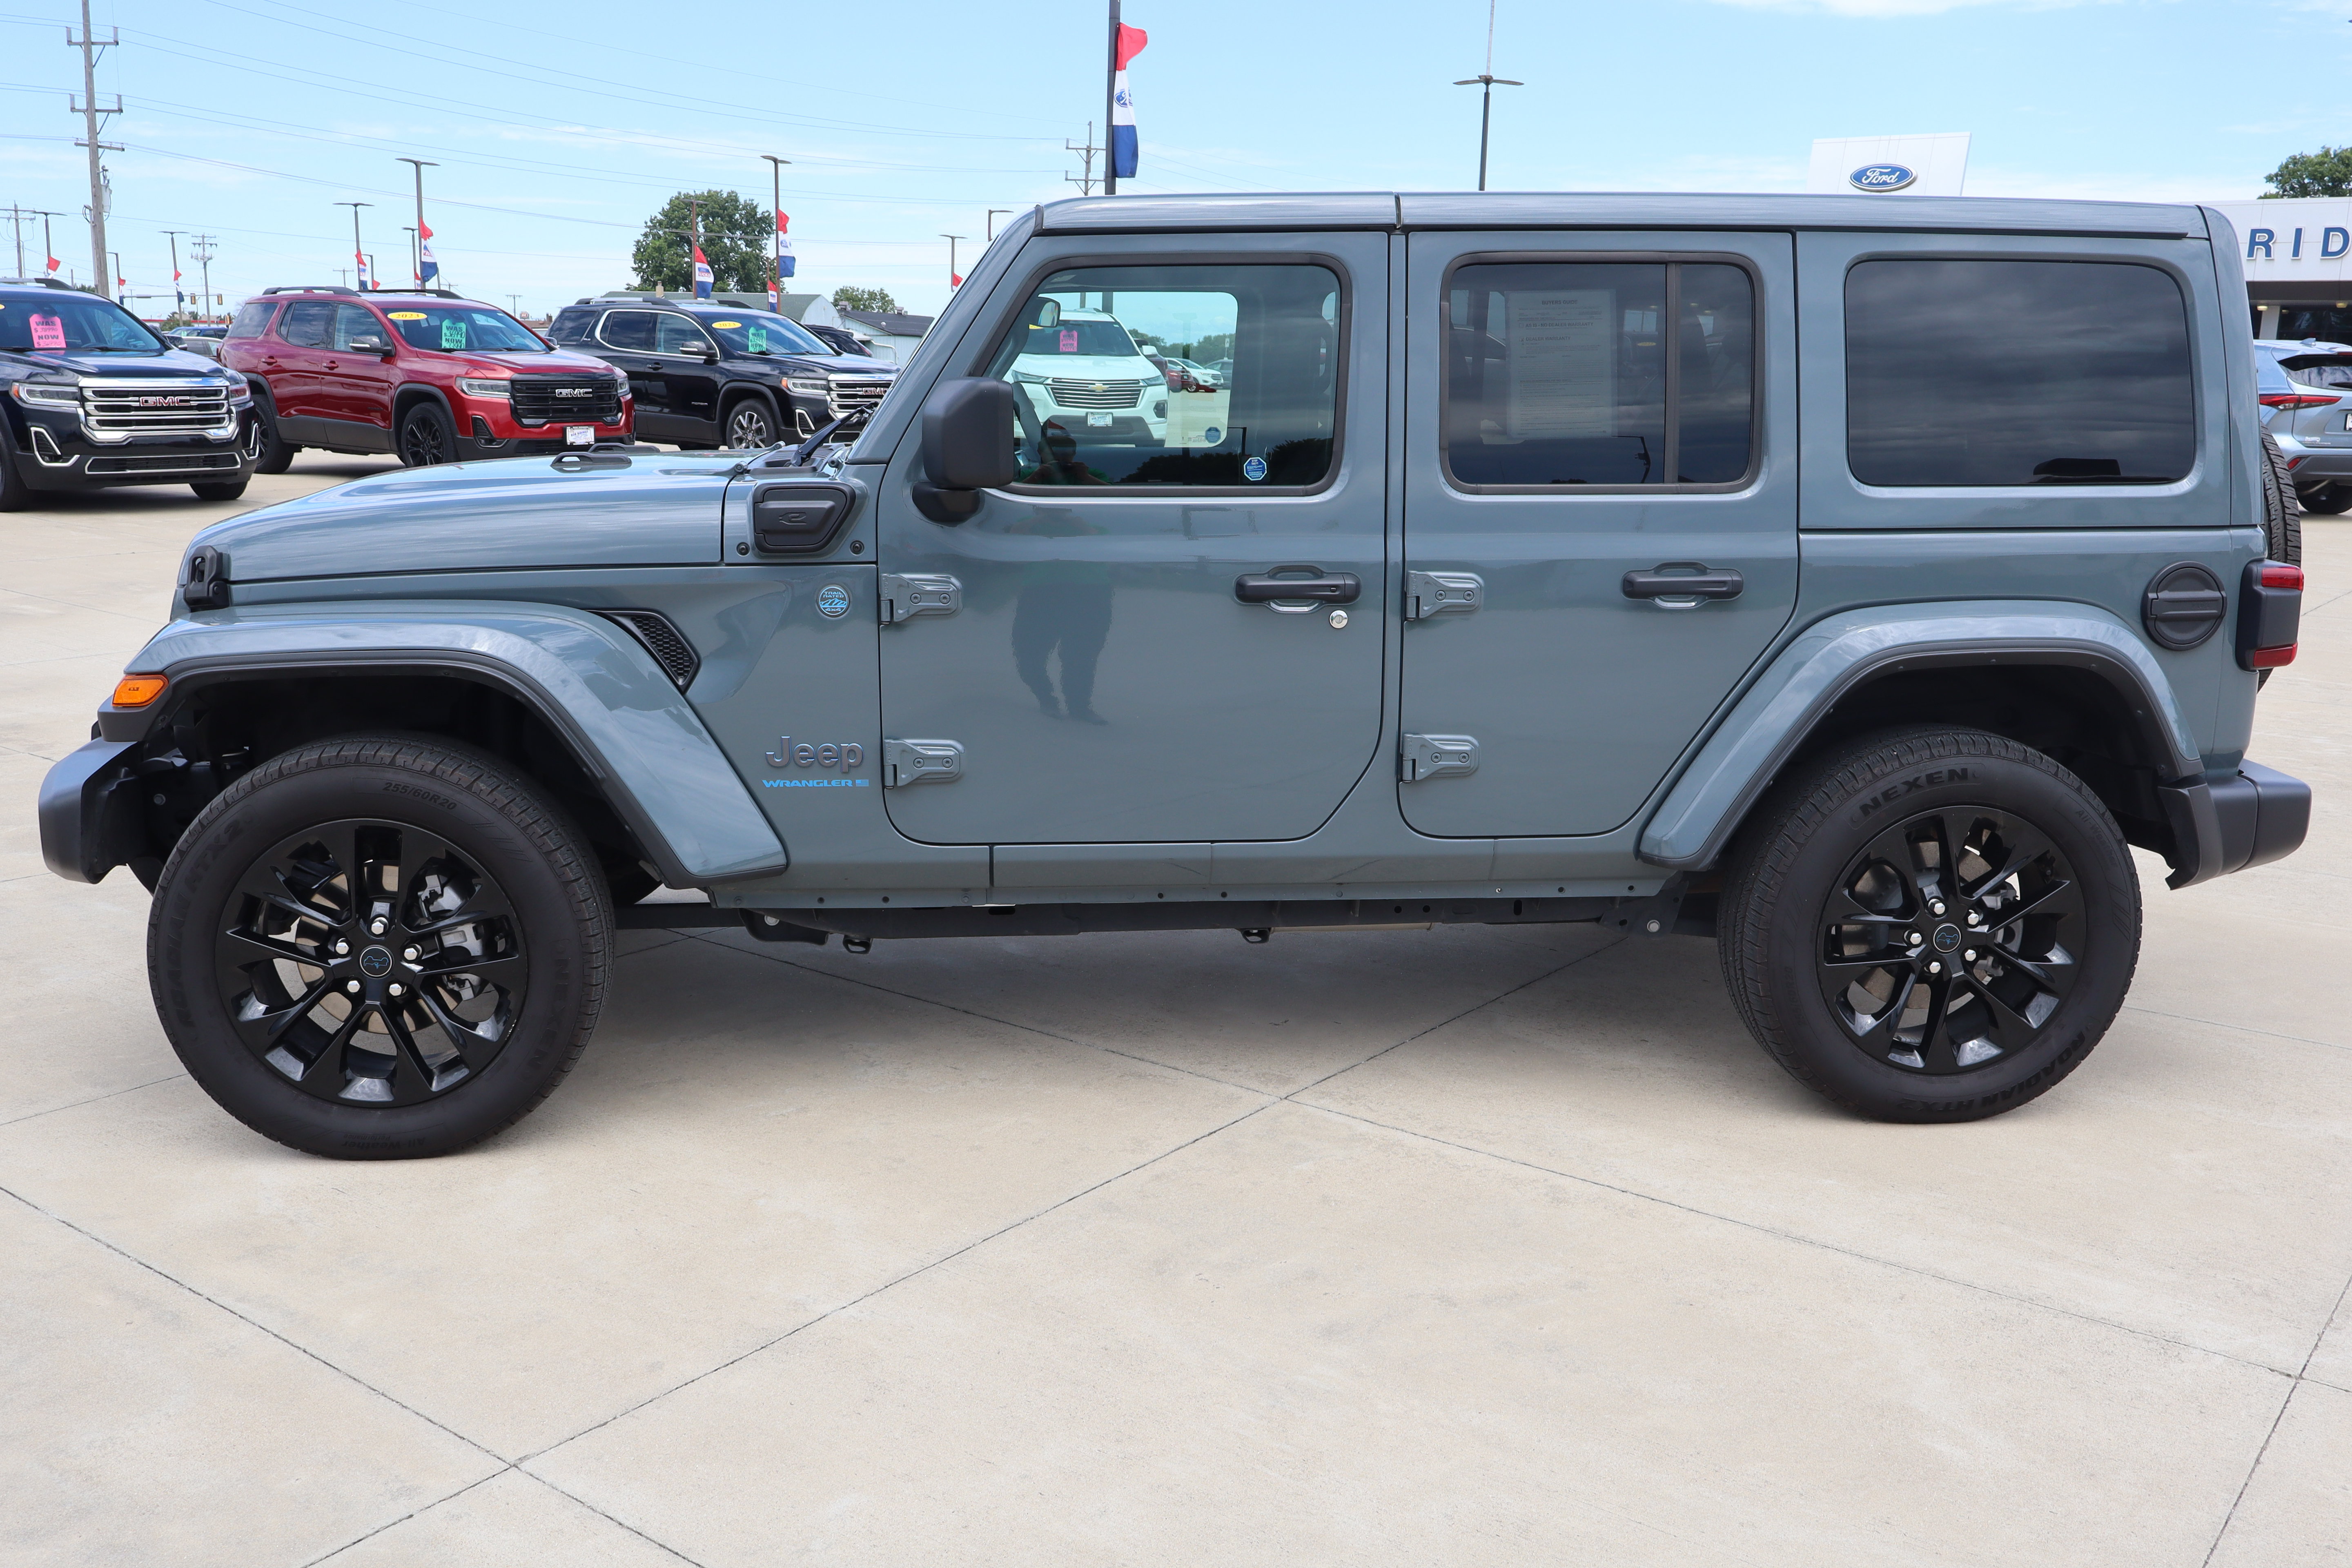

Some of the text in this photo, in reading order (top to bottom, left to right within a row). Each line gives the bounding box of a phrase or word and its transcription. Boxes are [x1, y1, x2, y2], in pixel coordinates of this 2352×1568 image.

[1862, 168, 1900, 183] Ford
[2246, 226, 2351, 259] RID
[140, 396, 190, 406] GMC
[556, 389, 592, 397] GMC
[765, 736, 864, 773] Jeep
[382, 782, 457, 810] 255/60R20
[1859, 768, 1968, 817] NEXEN
[1981, 1030, 2086, 1108] ROADIAN
[342, 1137, 425, 1150] All-Weather
